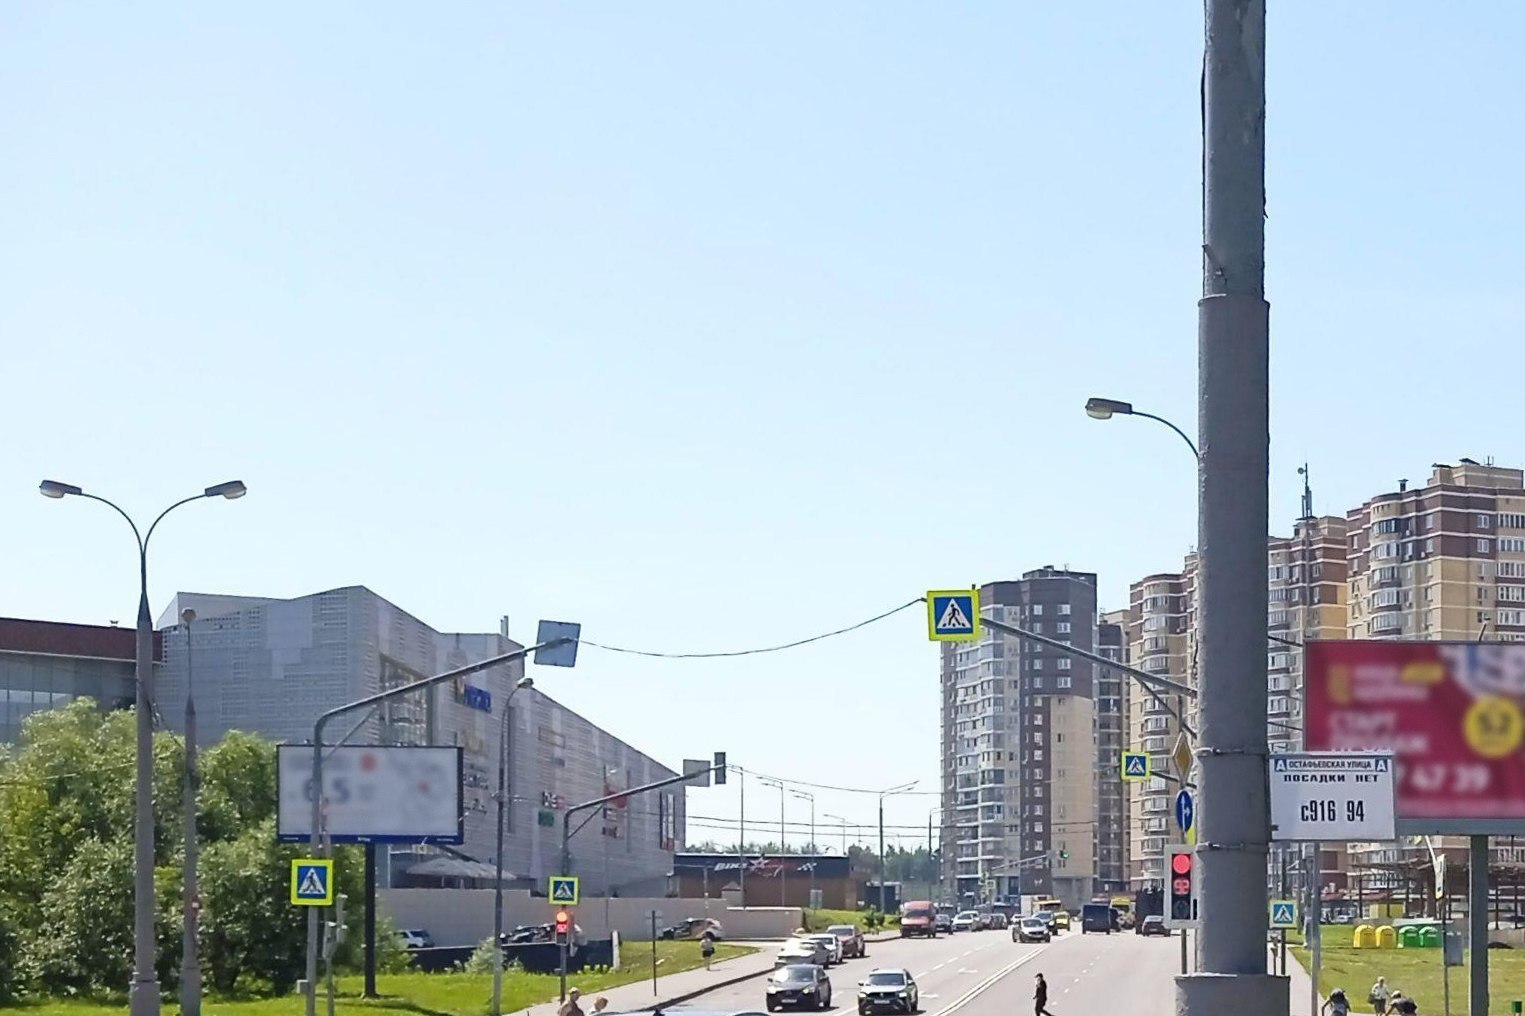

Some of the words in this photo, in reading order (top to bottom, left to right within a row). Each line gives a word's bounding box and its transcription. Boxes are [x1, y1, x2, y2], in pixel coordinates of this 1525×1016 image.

[1288, 760, 1346, 769] ОСТАФЬЕВСКАЯ
[1347, 760, 1372, 769] УЛИЦА
[1283, 774, 1346, 783] ПОСАДКИ
[1355, 774, 1379, 783] НЕТ
[1346, 800, 1365, 822] 94
